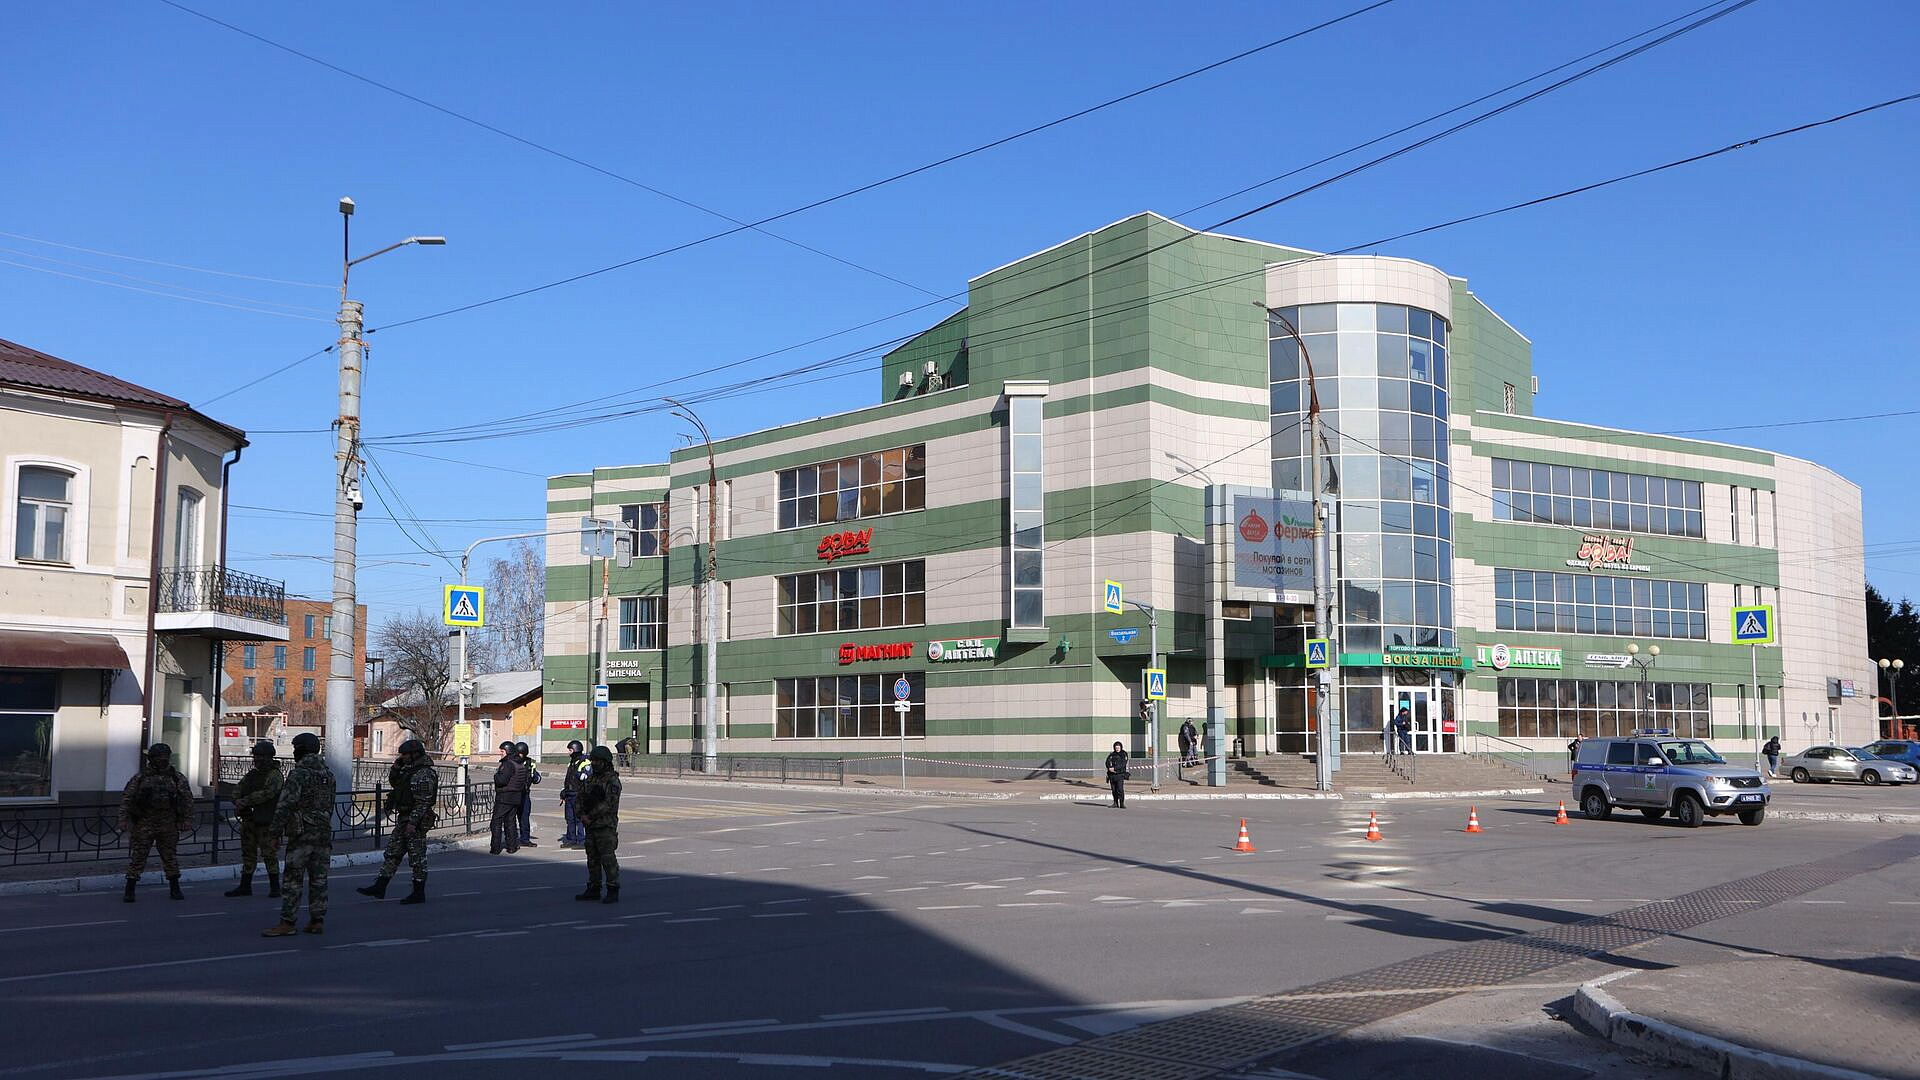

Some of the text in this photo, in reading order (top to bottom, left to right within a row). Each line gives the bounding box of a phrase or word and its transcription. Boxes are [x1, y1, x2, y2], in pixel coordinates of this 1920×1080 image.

[1294, 556, 1311, 565] сети
[856, 642, 913, 660] МАГНИТ
[944, 647, 995, 660] АПТЕКА
[1515, 650, 1561, 665] АПТЕКА
